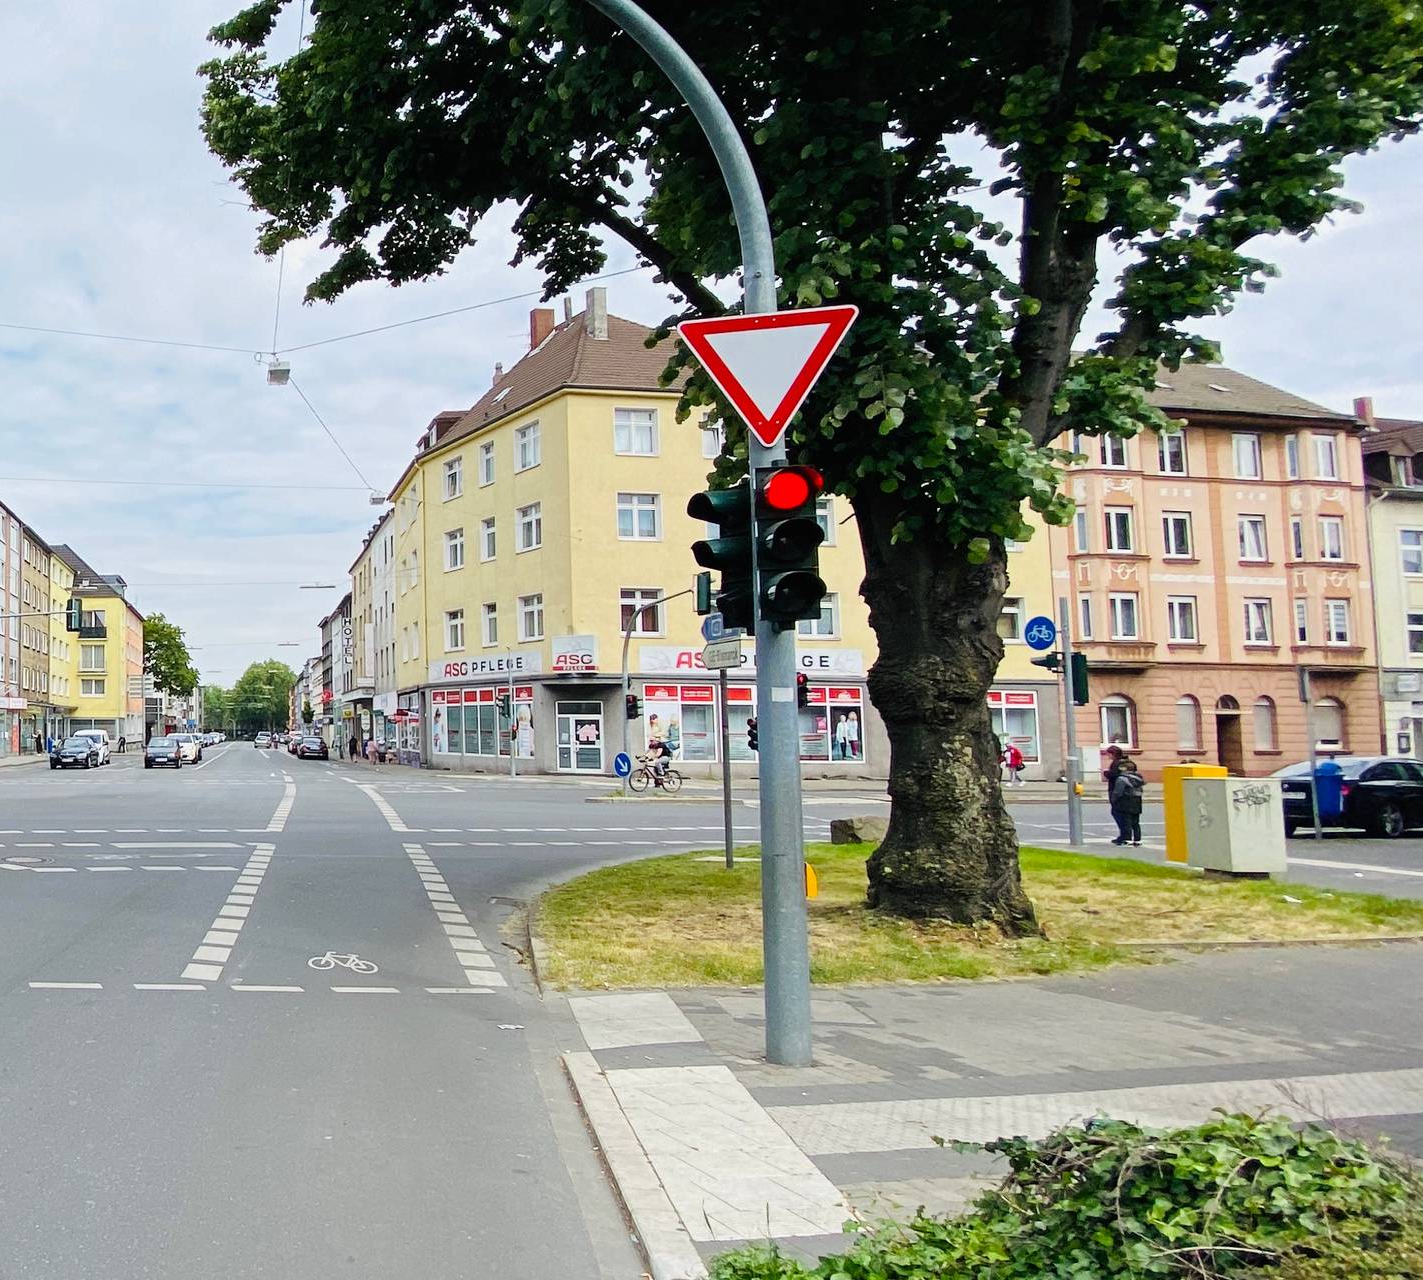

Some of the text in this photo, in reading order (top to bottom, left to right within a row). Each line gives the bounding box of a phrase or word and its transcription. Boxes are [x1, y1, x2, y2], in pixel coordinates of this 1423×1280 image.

[344, 618, 352, 664] HOTEL
[444, 657, 523, 677] ASG PFLEGE
[557, 654, 593, 665] ASG
[675, 652, 707, 668] AS
